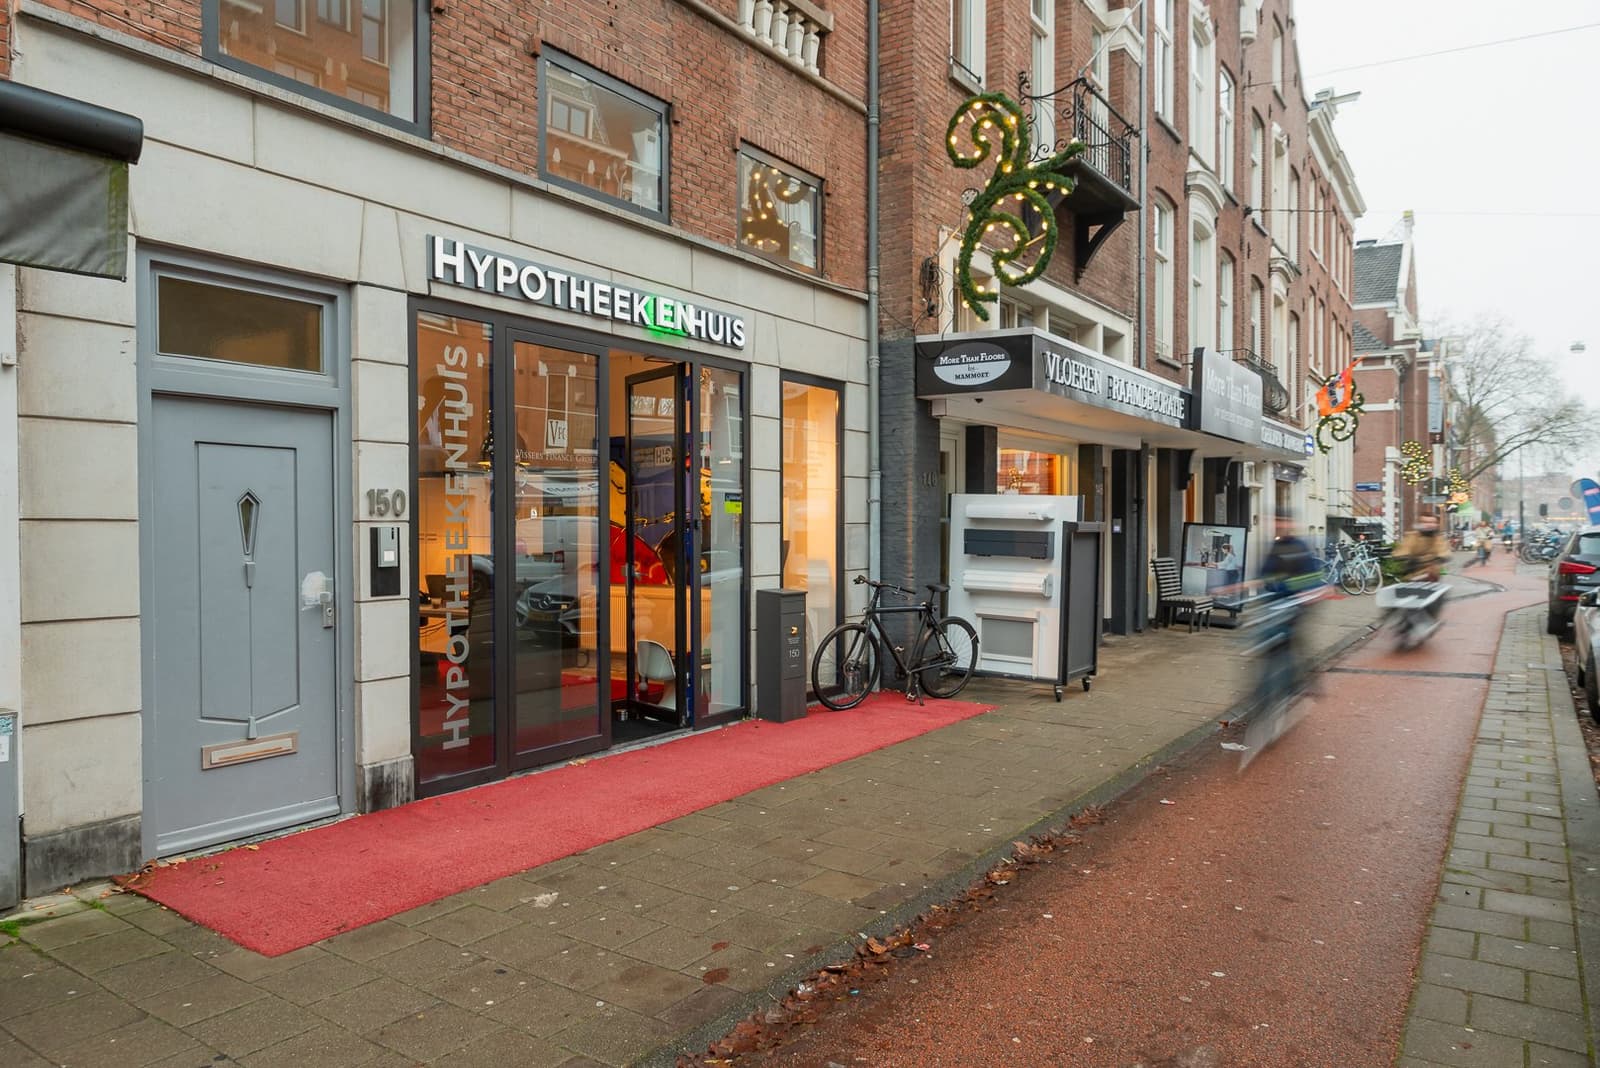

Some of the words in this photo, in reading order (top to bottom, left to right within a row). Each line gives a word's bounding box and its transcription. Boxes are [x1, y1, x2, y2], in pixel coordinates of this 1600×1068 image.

[1044, 351, 1102, 395] VLOEREN
[366, 488, 406, 517] 150
[442, 345, 470, 750] HYPOTHEEKENHUIS
